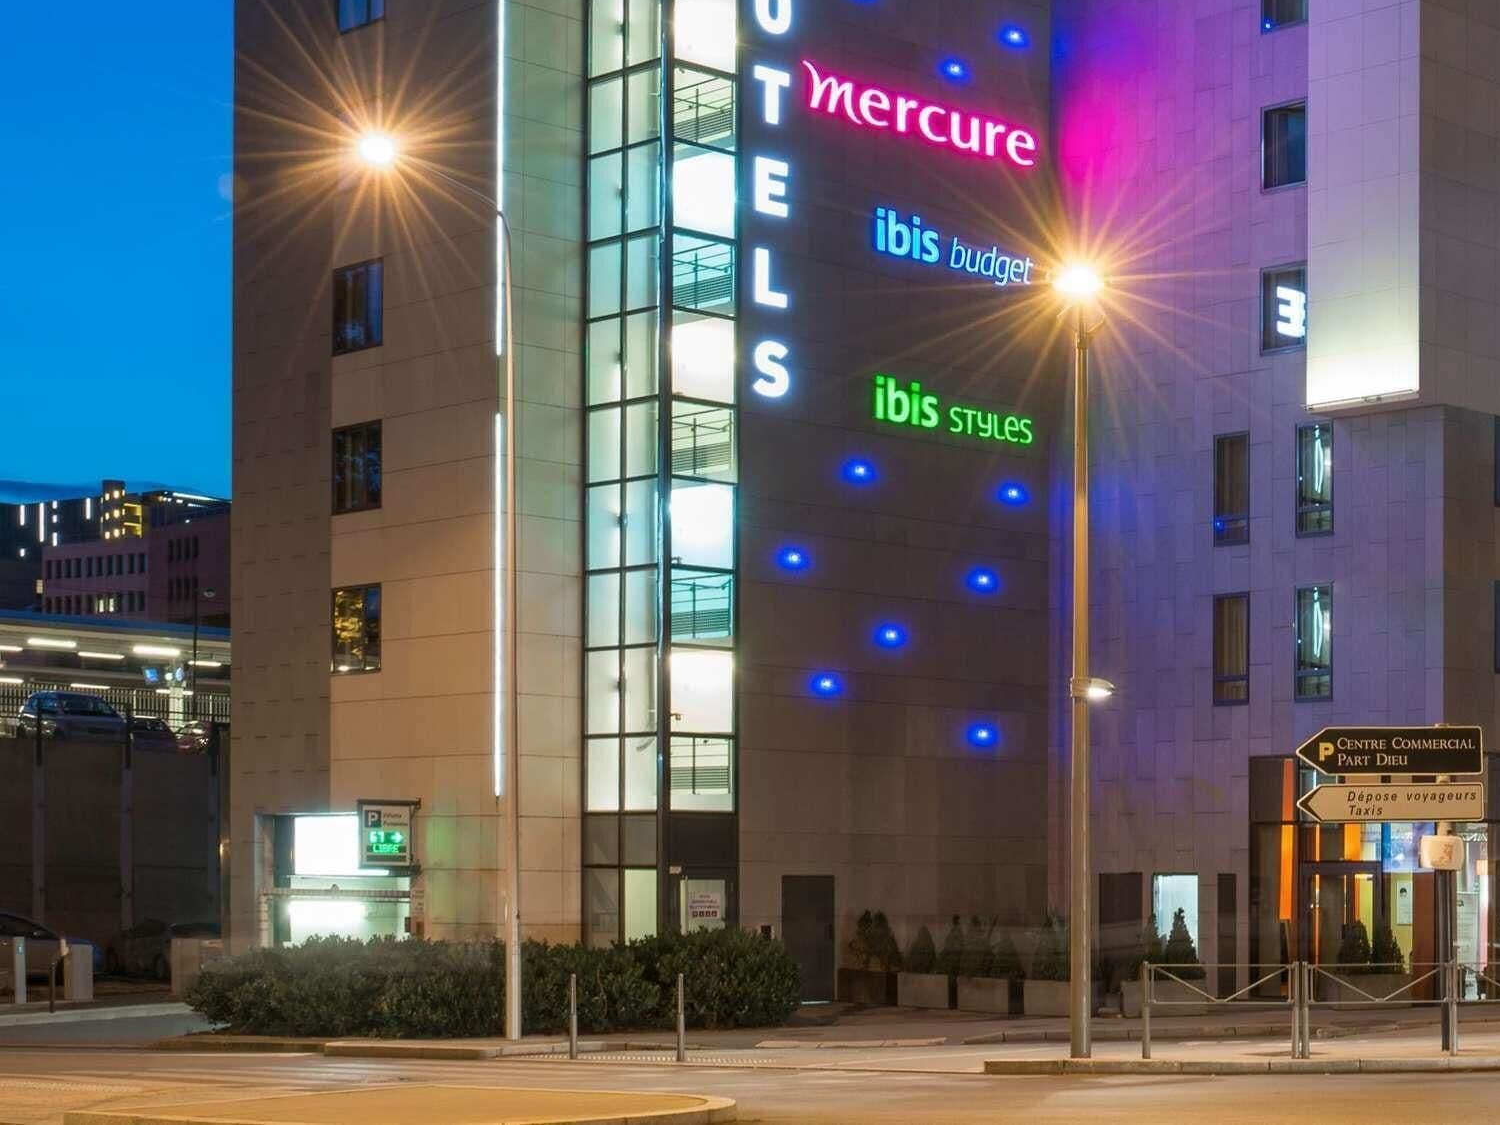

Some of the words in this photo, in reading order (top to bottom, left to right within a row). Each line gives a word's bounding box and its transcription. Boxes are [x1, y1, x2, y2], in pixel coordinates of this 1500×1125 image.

[802, 59, 1037, 166] mercure
[876, 207, 941, 264] ibis
[949, 237, 1035, 286] budget
[875, 375, 940, 428] ibis
[1319, 742, 1335, 761] P
[1337, 737, 1387, 750] CENTRE
[1391, 737, 1476, 750] COMMERCIAL
[1337, 753, 1371, 766] PART
[1376, 753, 1409, 766] DIEU
[1347, 790, 1398, 805] Dépose
[1406, 790, 1477, 805] voyageurs
[1348, 805, 1383, 816] Taxis
[368, 811, 379, 827] P
